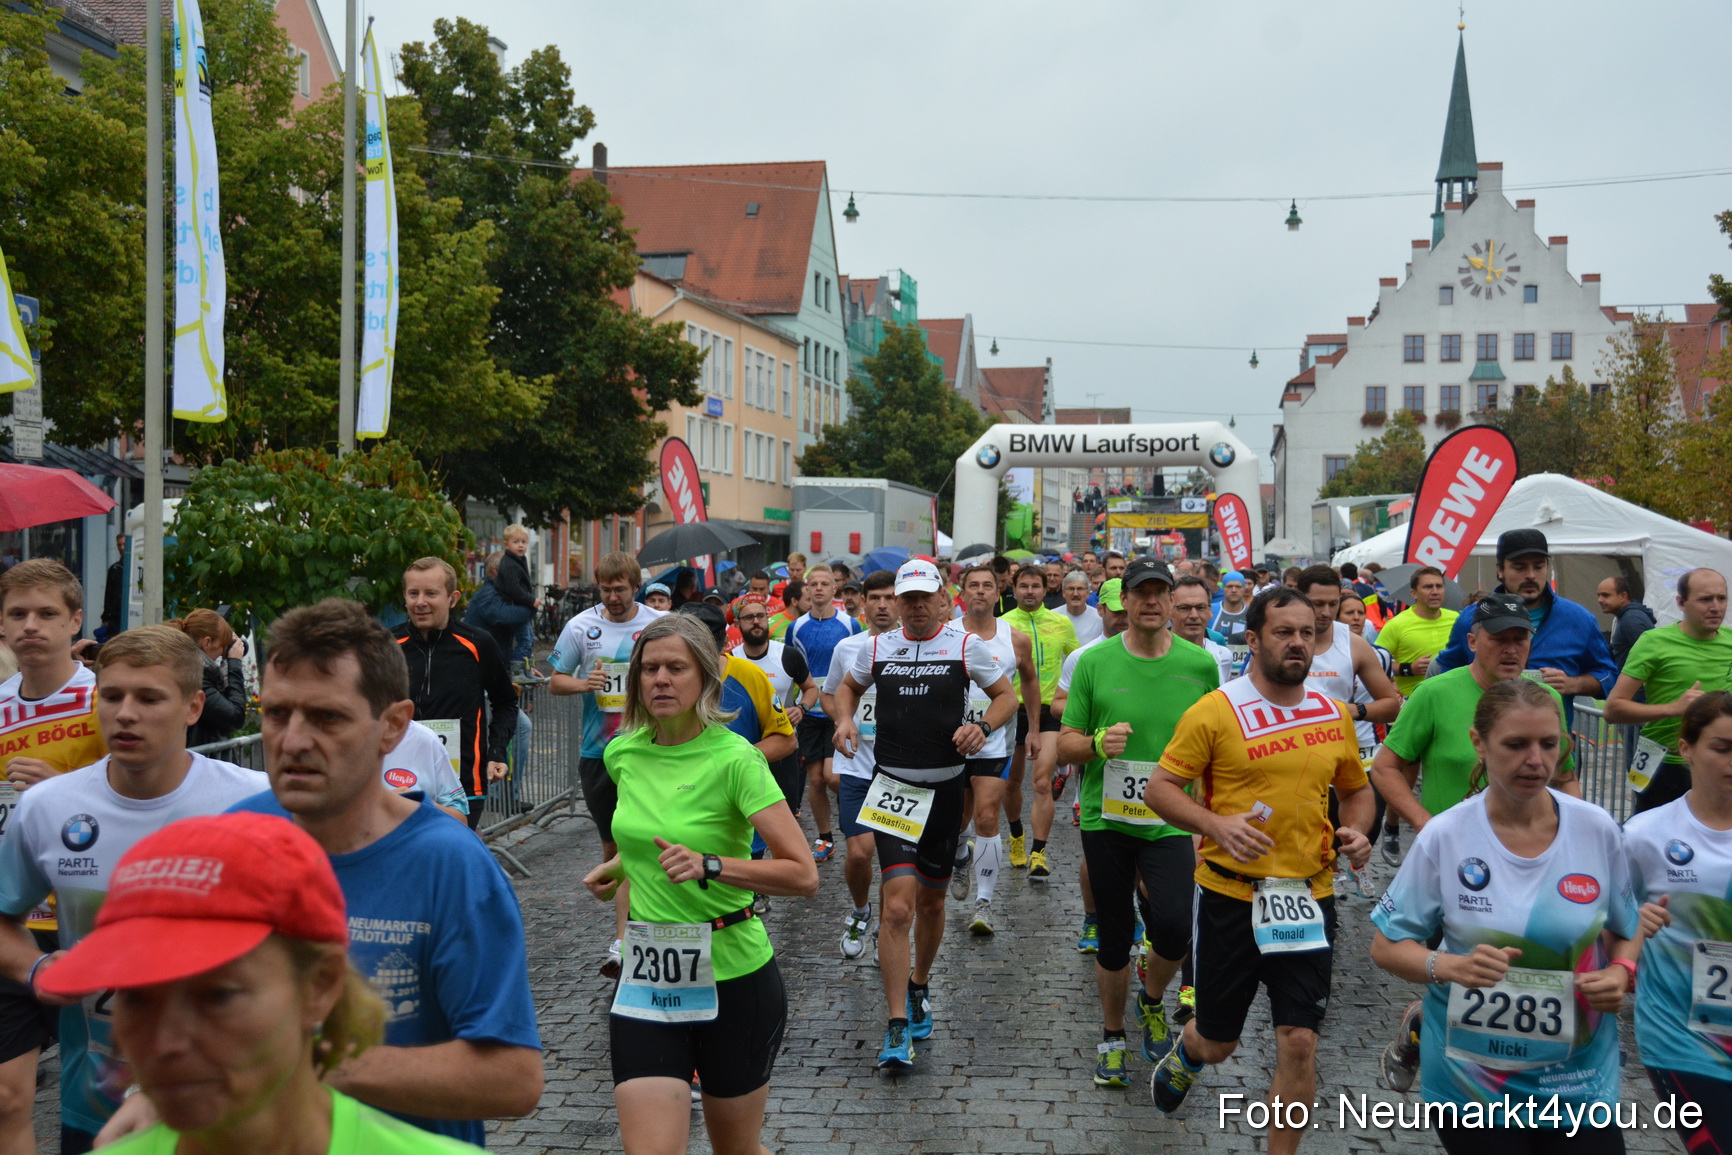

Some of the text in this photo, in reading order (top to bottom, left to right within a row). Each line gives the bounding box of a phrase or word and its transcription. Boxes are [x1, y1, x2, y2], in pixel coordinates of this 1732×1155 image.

[1009, 433, 1076, 453] BMW
[1081, 432, 1200, 457] Laufsport
[1414, 446, 1502, 573] REWE
[1146, 516, 1169, 526] ZIEL
[1219, 501, 1249, 564] REWE
[881, 662, 951, 679] Energizer
[37, 722, 97, 746] BÖGL
[1247, 727, 1345, 760] MAX BÖGL
[877, 791, 919, 817] 237
[1122, 805, 1147, 816] Peter
[871, 812, 911, 832] Sebastian
[58, 857, 99, 869] PARTL
[58, 868, 99, 877] Neumarkt
[1667, 869, 1697, 878] PARTL
[1563, 881, 1597, 896] Hervis
[1258, 893, 1316, 924] 2686
[1458, 894, 1493, 907] PARTL
[1458, 903, 1493, 913] Neumarkt
[348, 916, 432, 935] NEUMARKTER
[654, 926, 702, 939] BOCK
[1271, 927, 1305, 940] Ronald
[632, 944, 702, 984] 2307
[1506, 970, 1564, 988] BOCK
[651, 991, 681, 1008] Karin
[1460, 988, 1563, 1036] 2283
[1487, 1039, 1528, 1058] Nicki
